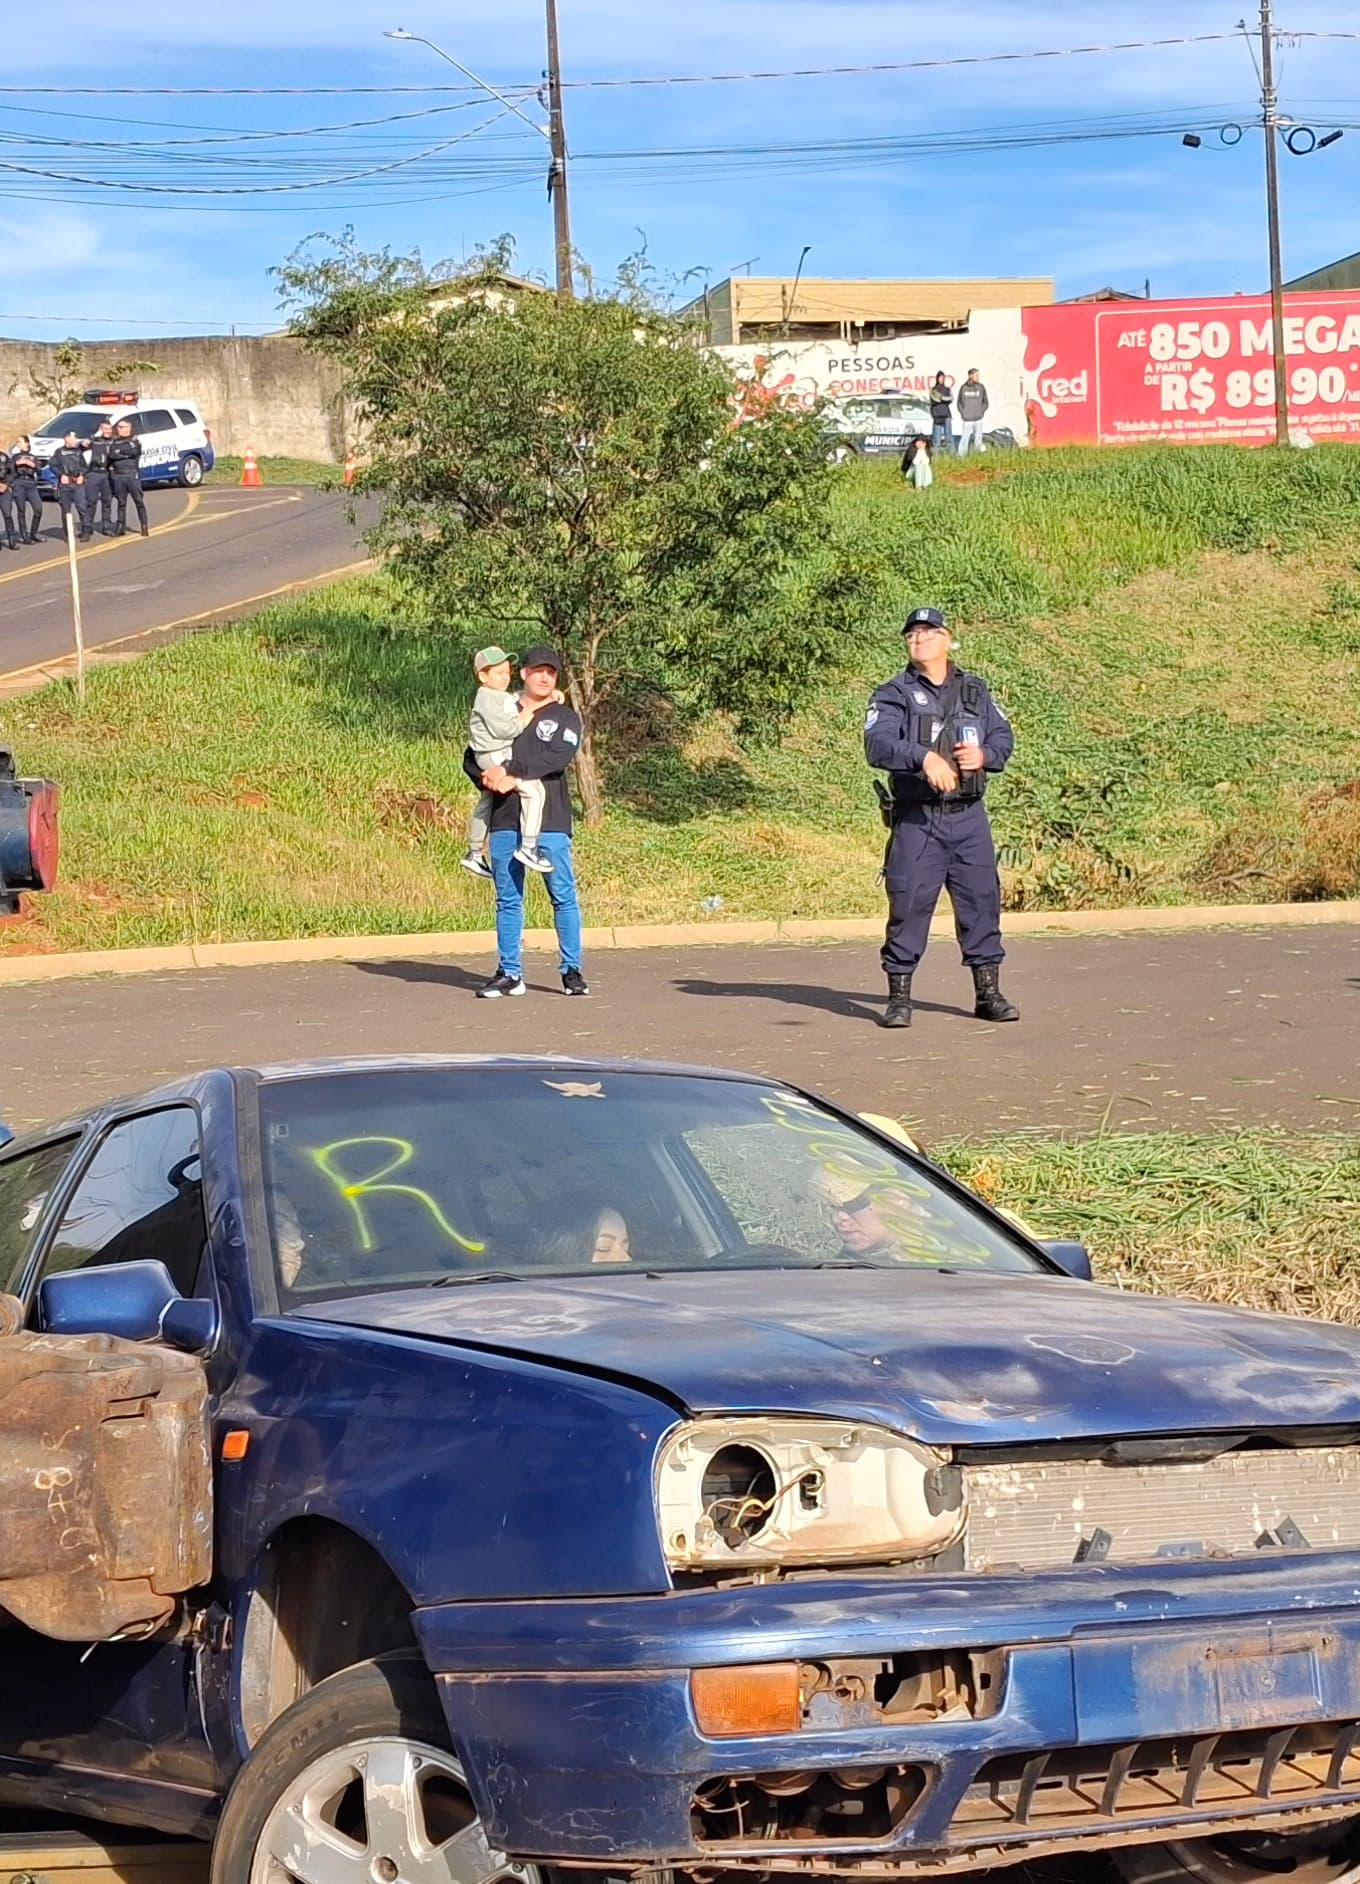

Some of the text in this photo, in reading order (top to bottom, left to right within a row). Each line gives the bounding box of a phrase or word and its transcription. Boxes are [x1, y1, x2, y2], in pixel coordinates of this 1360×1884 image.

[1117, 327, 1146, 349] ATÉ
[1149, 321, 1230, 361] 850
[828, 356, 915, 373] PESSOAS
[1144, 361, 1193, 373] A PARTIR
[1041, 369, 1088, 398] red
[1144, 375, 1160, 386] DE
[1161, 367, 1216, 414] R$
[312, 1136, 486, 1252] R
